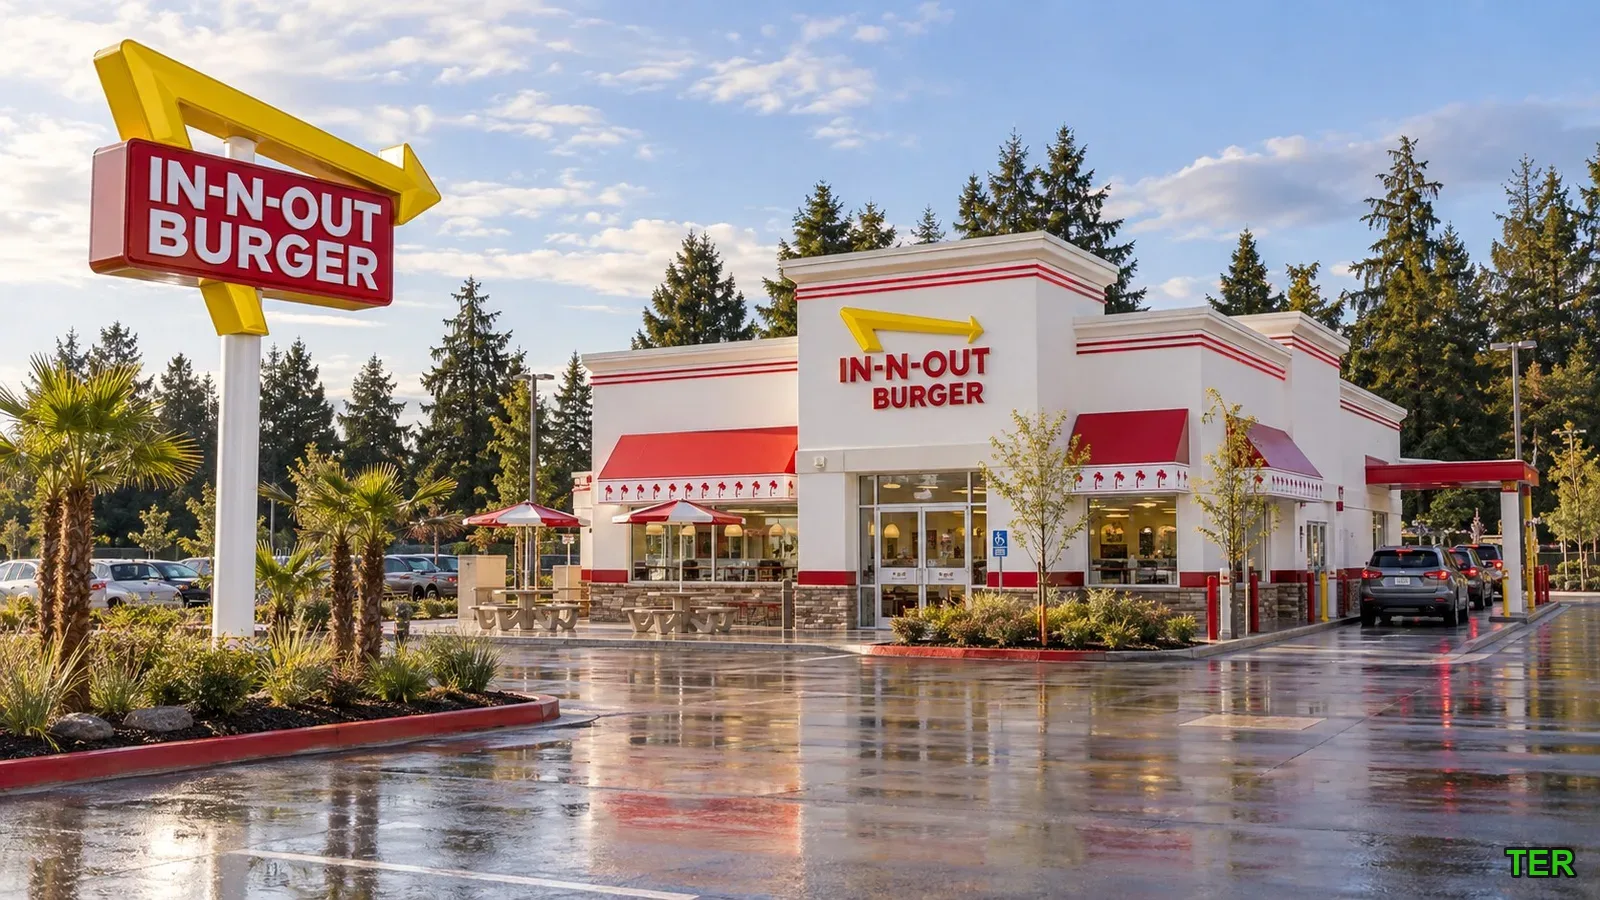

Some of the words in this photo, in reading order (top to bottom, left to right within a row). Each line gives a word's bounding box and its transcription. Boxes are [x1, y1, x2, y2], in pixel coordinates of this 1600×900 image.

[150, 156, 381, 243] IN-N-OUT
[149, 208, 378, 290] BURGER
[839, 347, 990, 383] IN-N-OUT
[873, 382, 985, 410] BURGER
